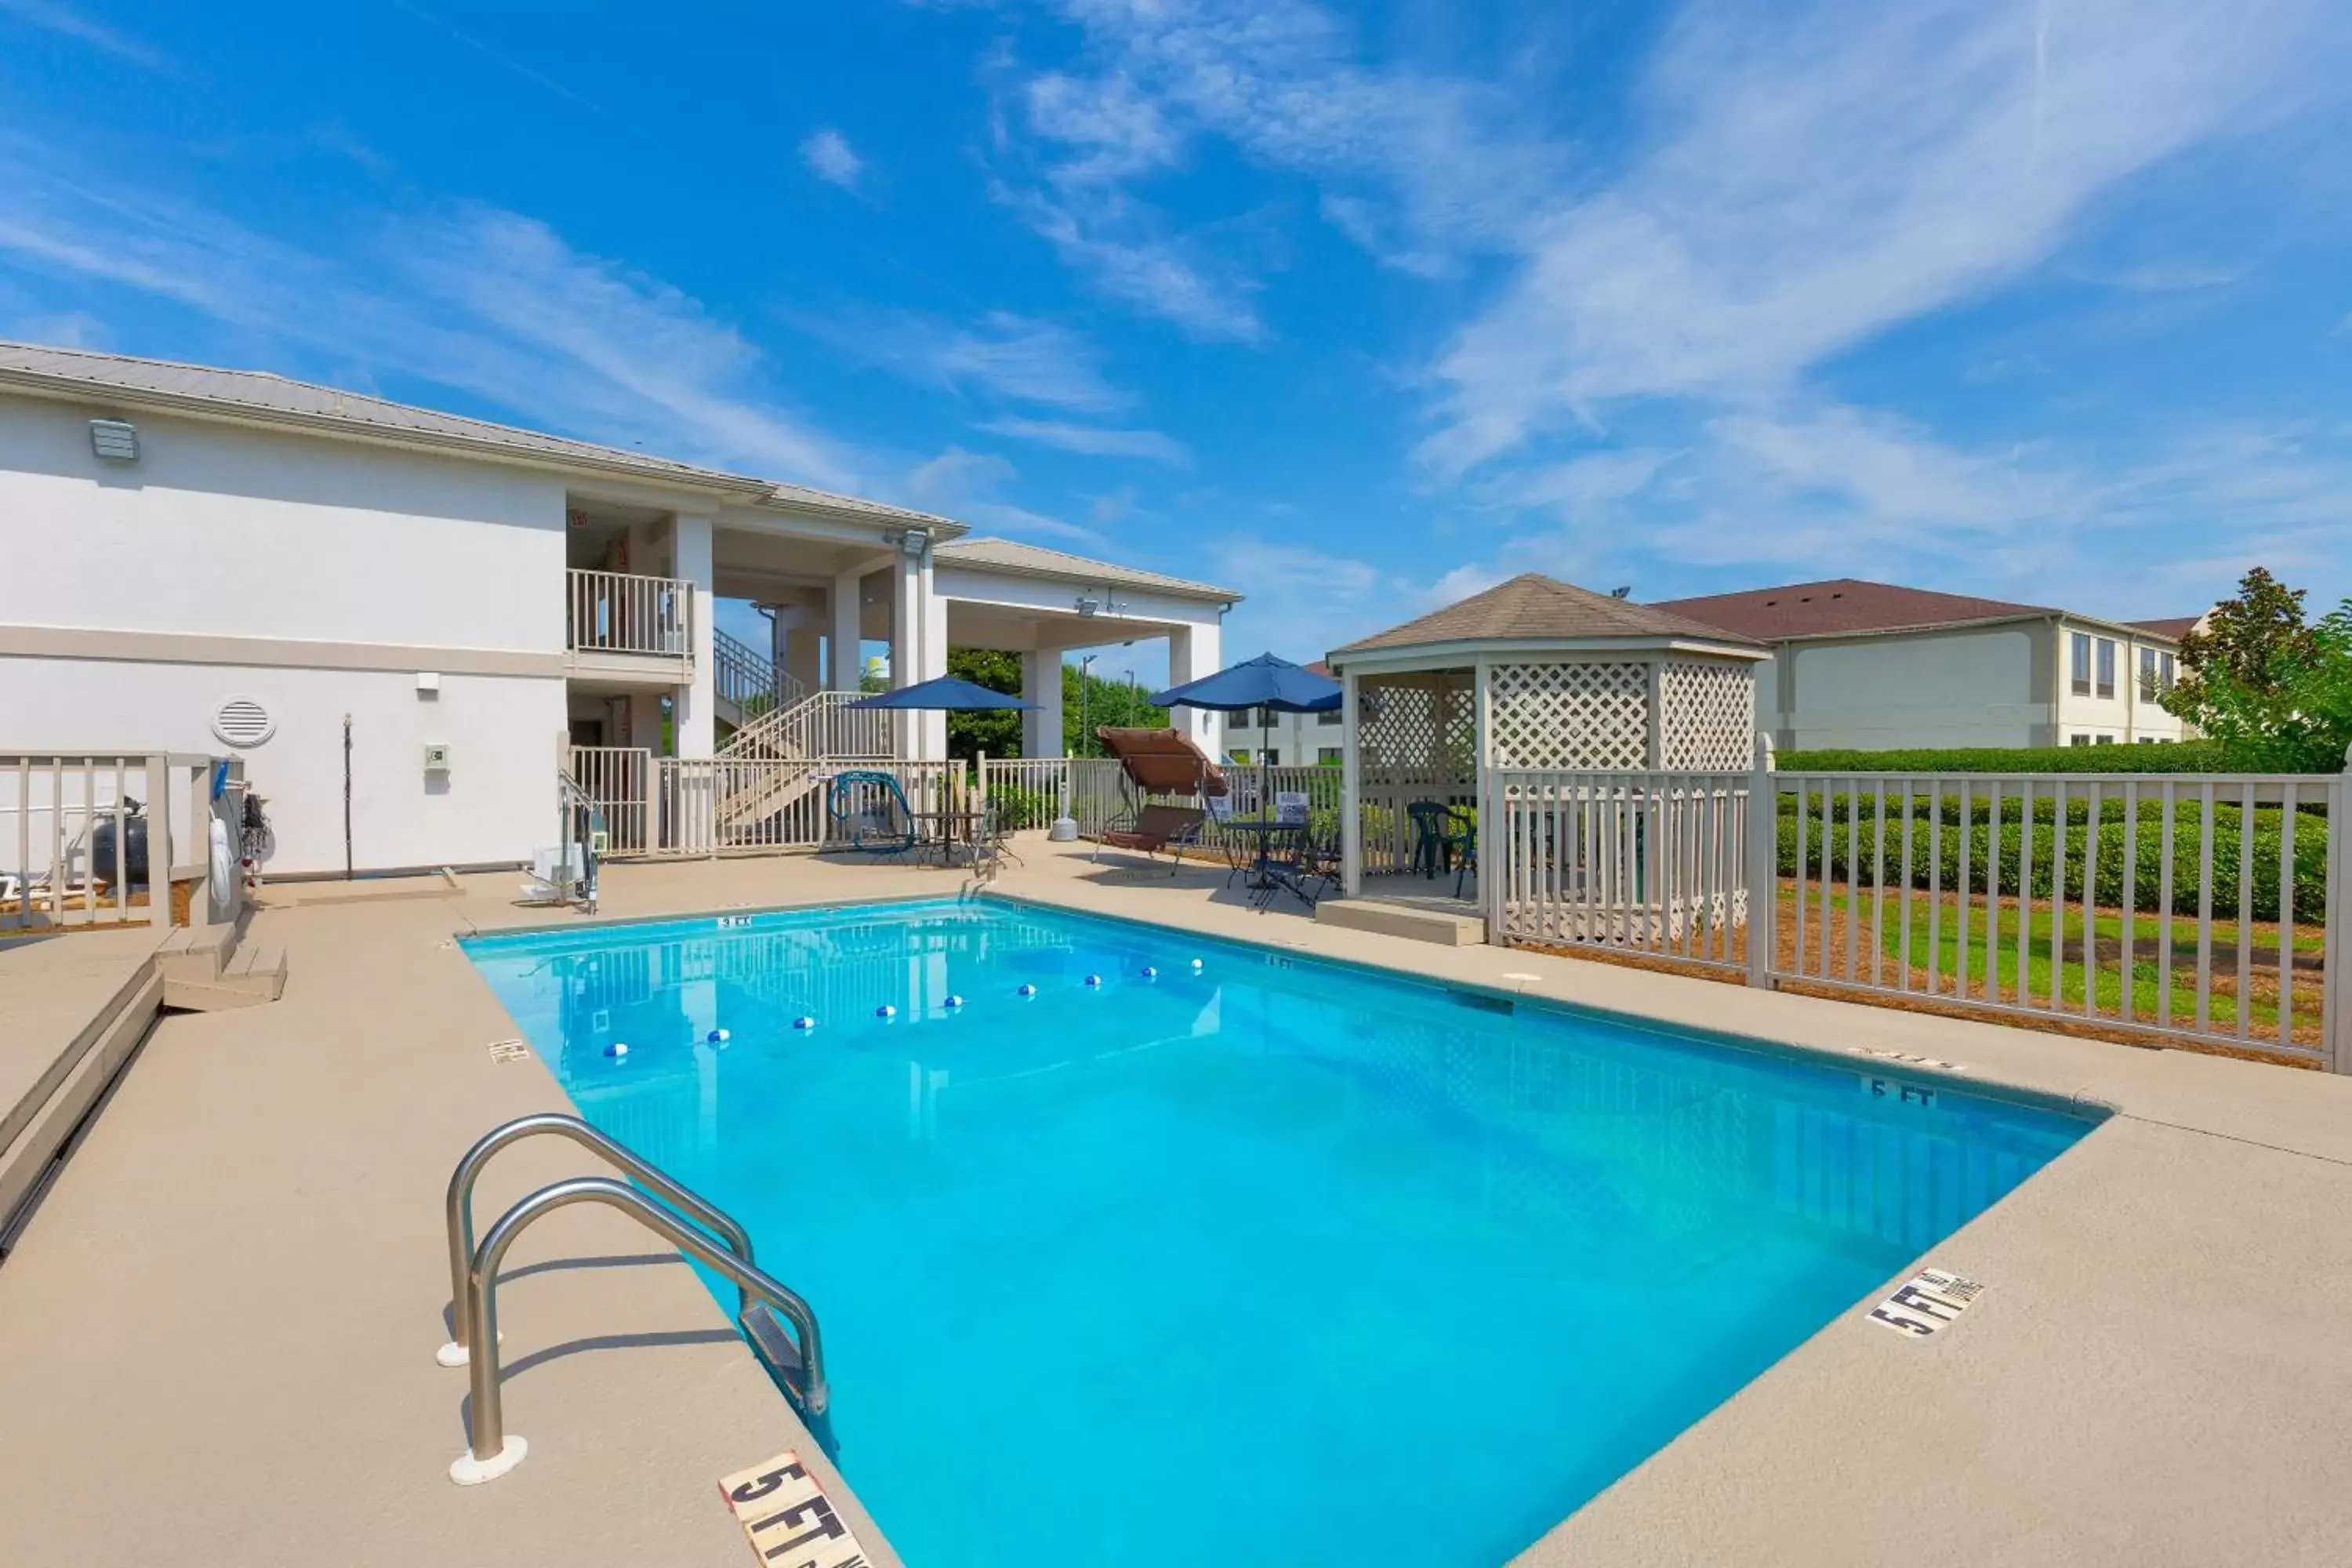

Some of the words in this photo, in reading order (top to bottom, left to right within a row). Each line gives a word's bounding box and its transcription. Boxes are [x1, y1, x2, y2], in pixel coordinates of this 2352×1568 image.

[1900, 1085, 1934, 1105] FT
[1890, 1285, 1963, 1321] FT
[1871, 1308, 1934, 1335] 5
[731, 1462, 806, 1502] 5
[751, 1495, 846, 1559] FT
